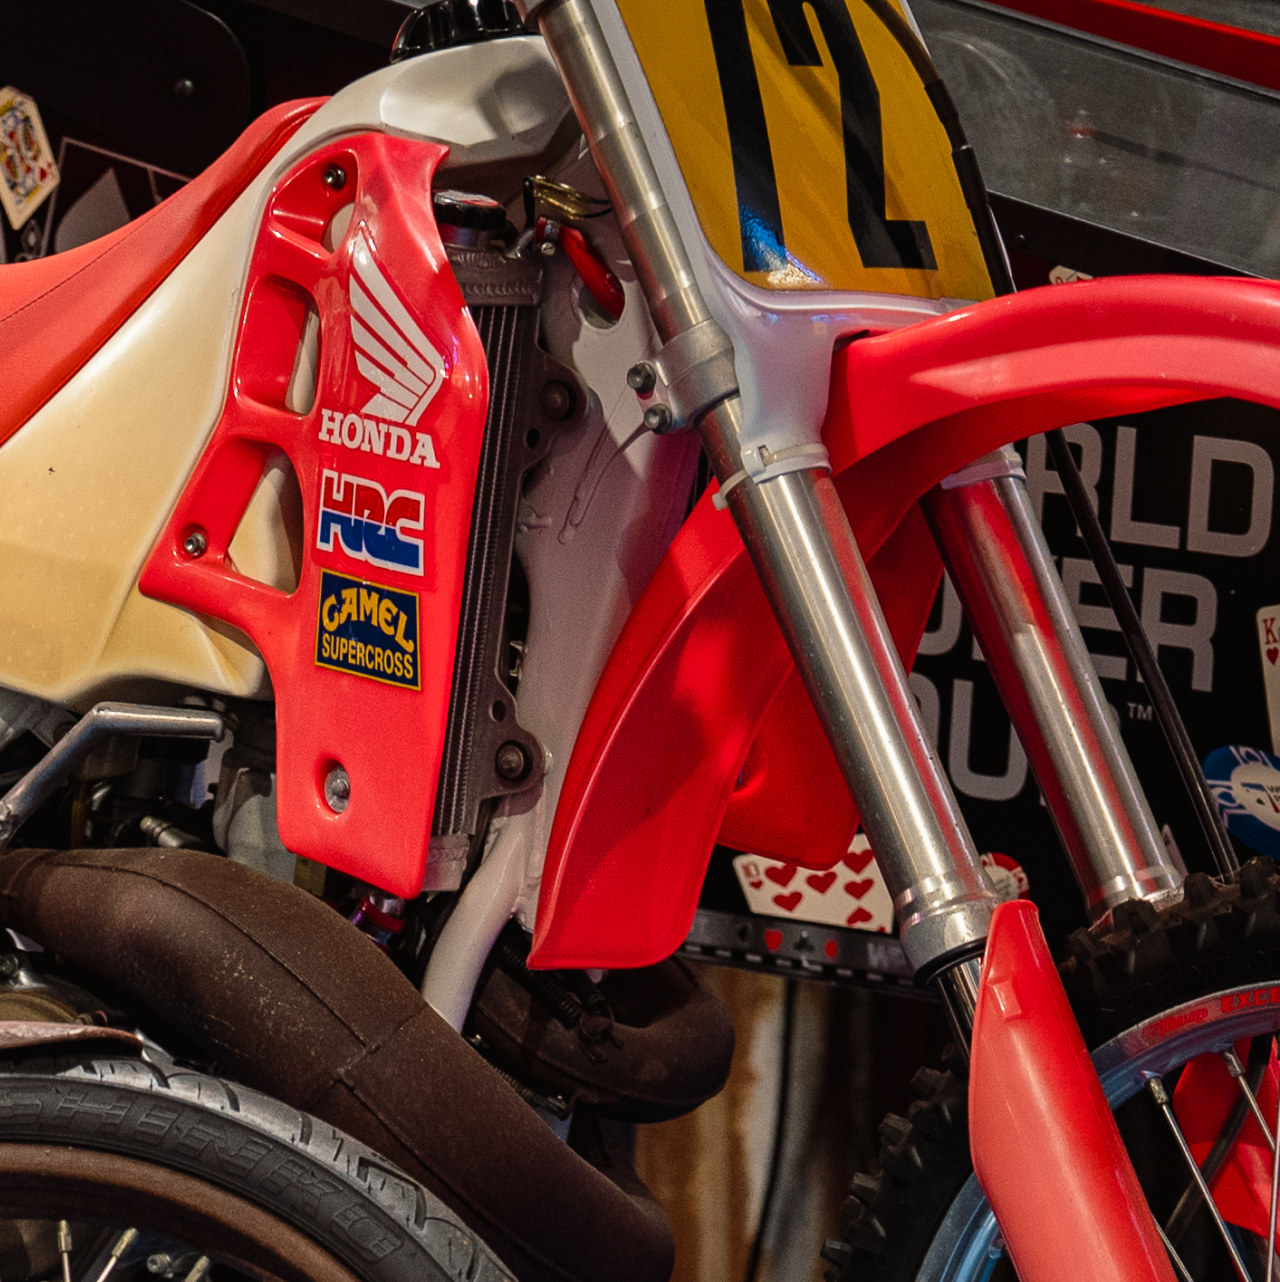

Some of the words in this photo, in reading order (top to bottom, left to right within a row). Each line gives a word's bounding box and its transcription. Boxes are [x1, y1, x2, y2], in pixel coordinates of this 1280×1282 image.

[318, 407, 440, 469] HONDA
[316, 468, 425, 577] HRC
[321, 587, 415, 654] CAMEL
[1263, 617, 1279, 646] K
[321, 632, 415, 680] SUPERCROSS
